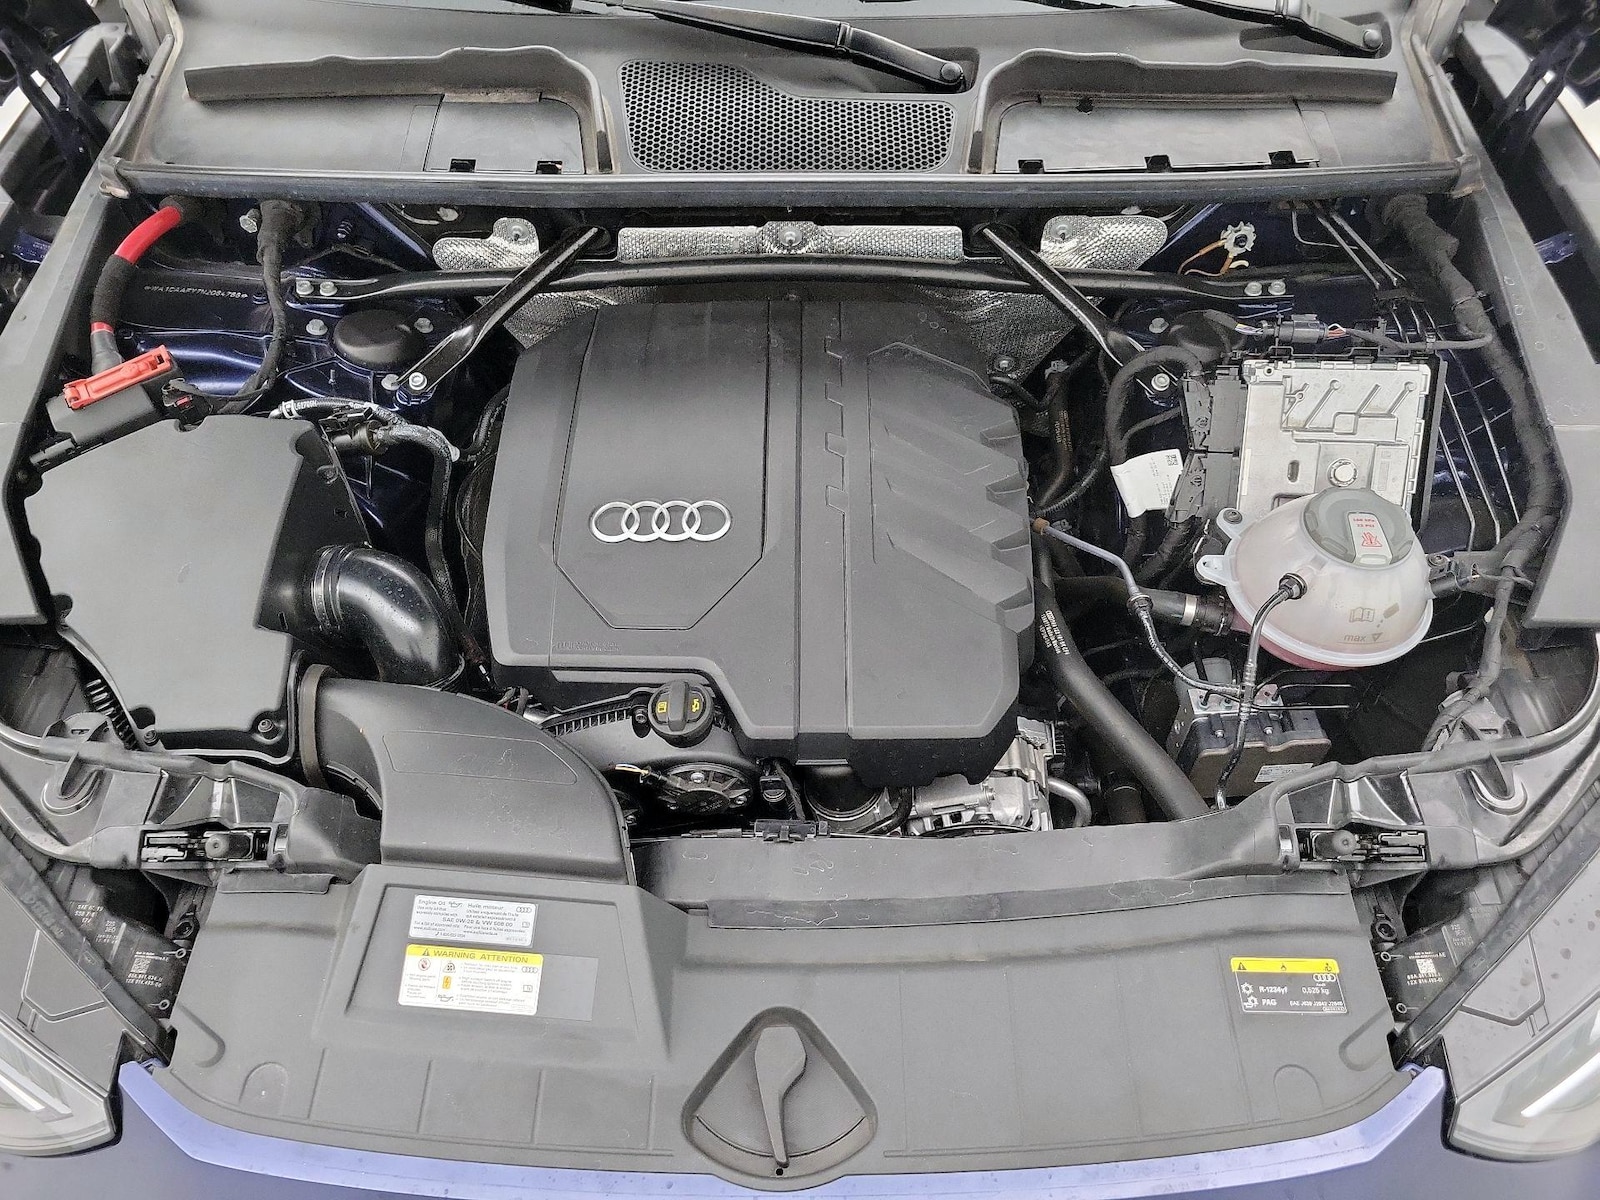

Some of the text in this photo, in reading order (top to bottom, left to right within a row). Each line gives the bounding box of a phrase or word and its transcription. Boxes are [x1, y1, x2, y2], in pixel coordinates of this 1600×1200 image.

[1344, 634, 1366, 642] max
[433, 949, 529, 964] WARNING ATTENTION
[1259, 986, 1288, 994] R-1234yf
[1320, 987, 1330, 995] kg
